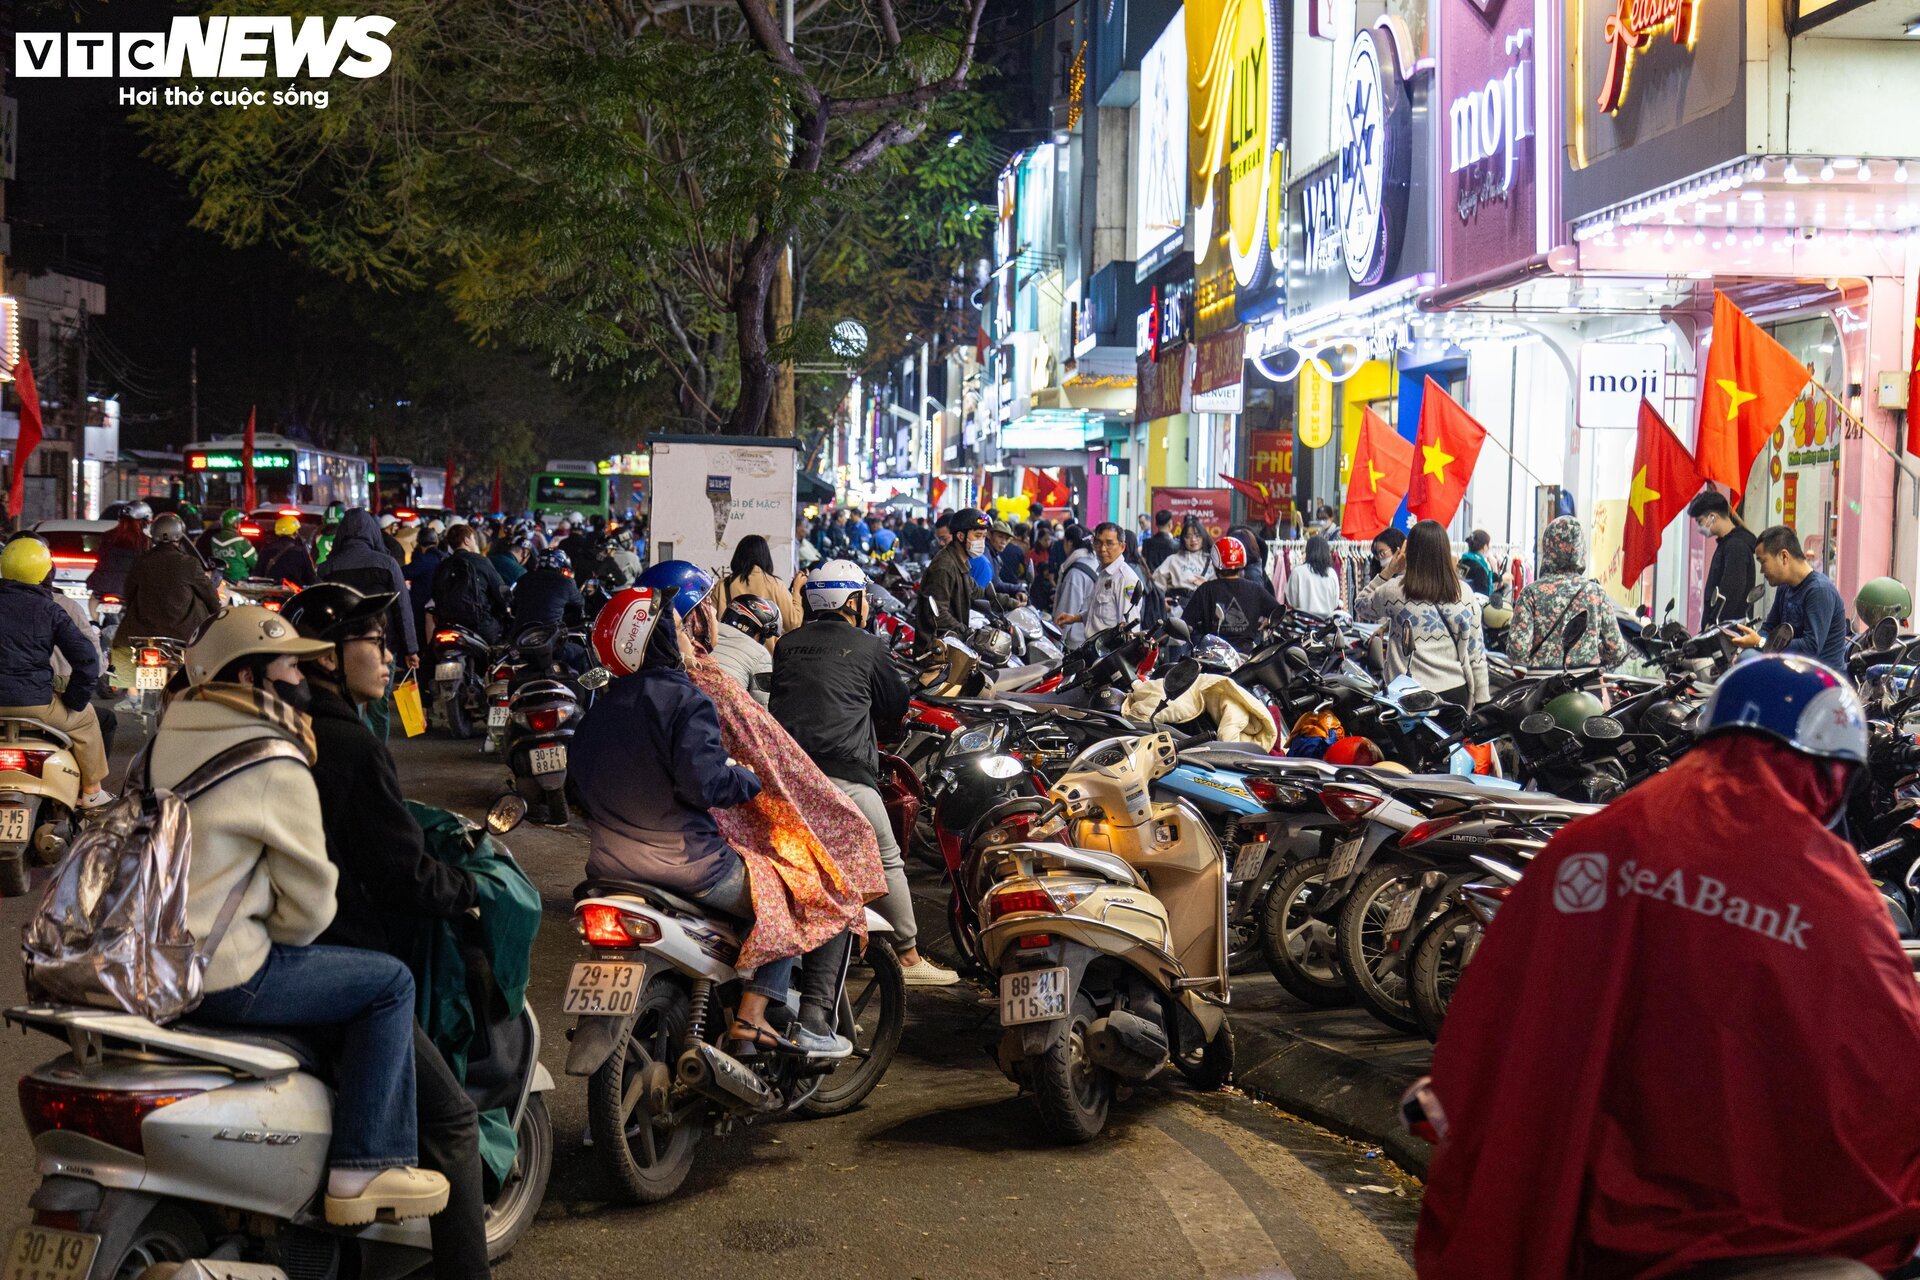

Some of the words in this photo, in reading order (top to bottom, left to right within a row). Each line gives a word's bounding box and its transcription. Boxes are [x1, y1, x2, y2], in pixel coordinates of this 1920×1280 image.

[1230, 36, 1264, 154] LILY
[1450, 28, 1533, 191] moji
[1589, 369, 1657, 398] moji
[1845, 416, 1863, 440] 241
[213, 547, 236, 558] Grab
[534, 747, 561, 761] 30-F4
[536, 759, 562, 773] 8841
[1452, 834, 1477, 843] LIMITED
[1616, 859, 1813, 951] SeABank
[578, 965, 633, 988] 29-Y3
[566, 988, 633, 1012] 755.00
[213, 1128, 302, 1146] LEAD
